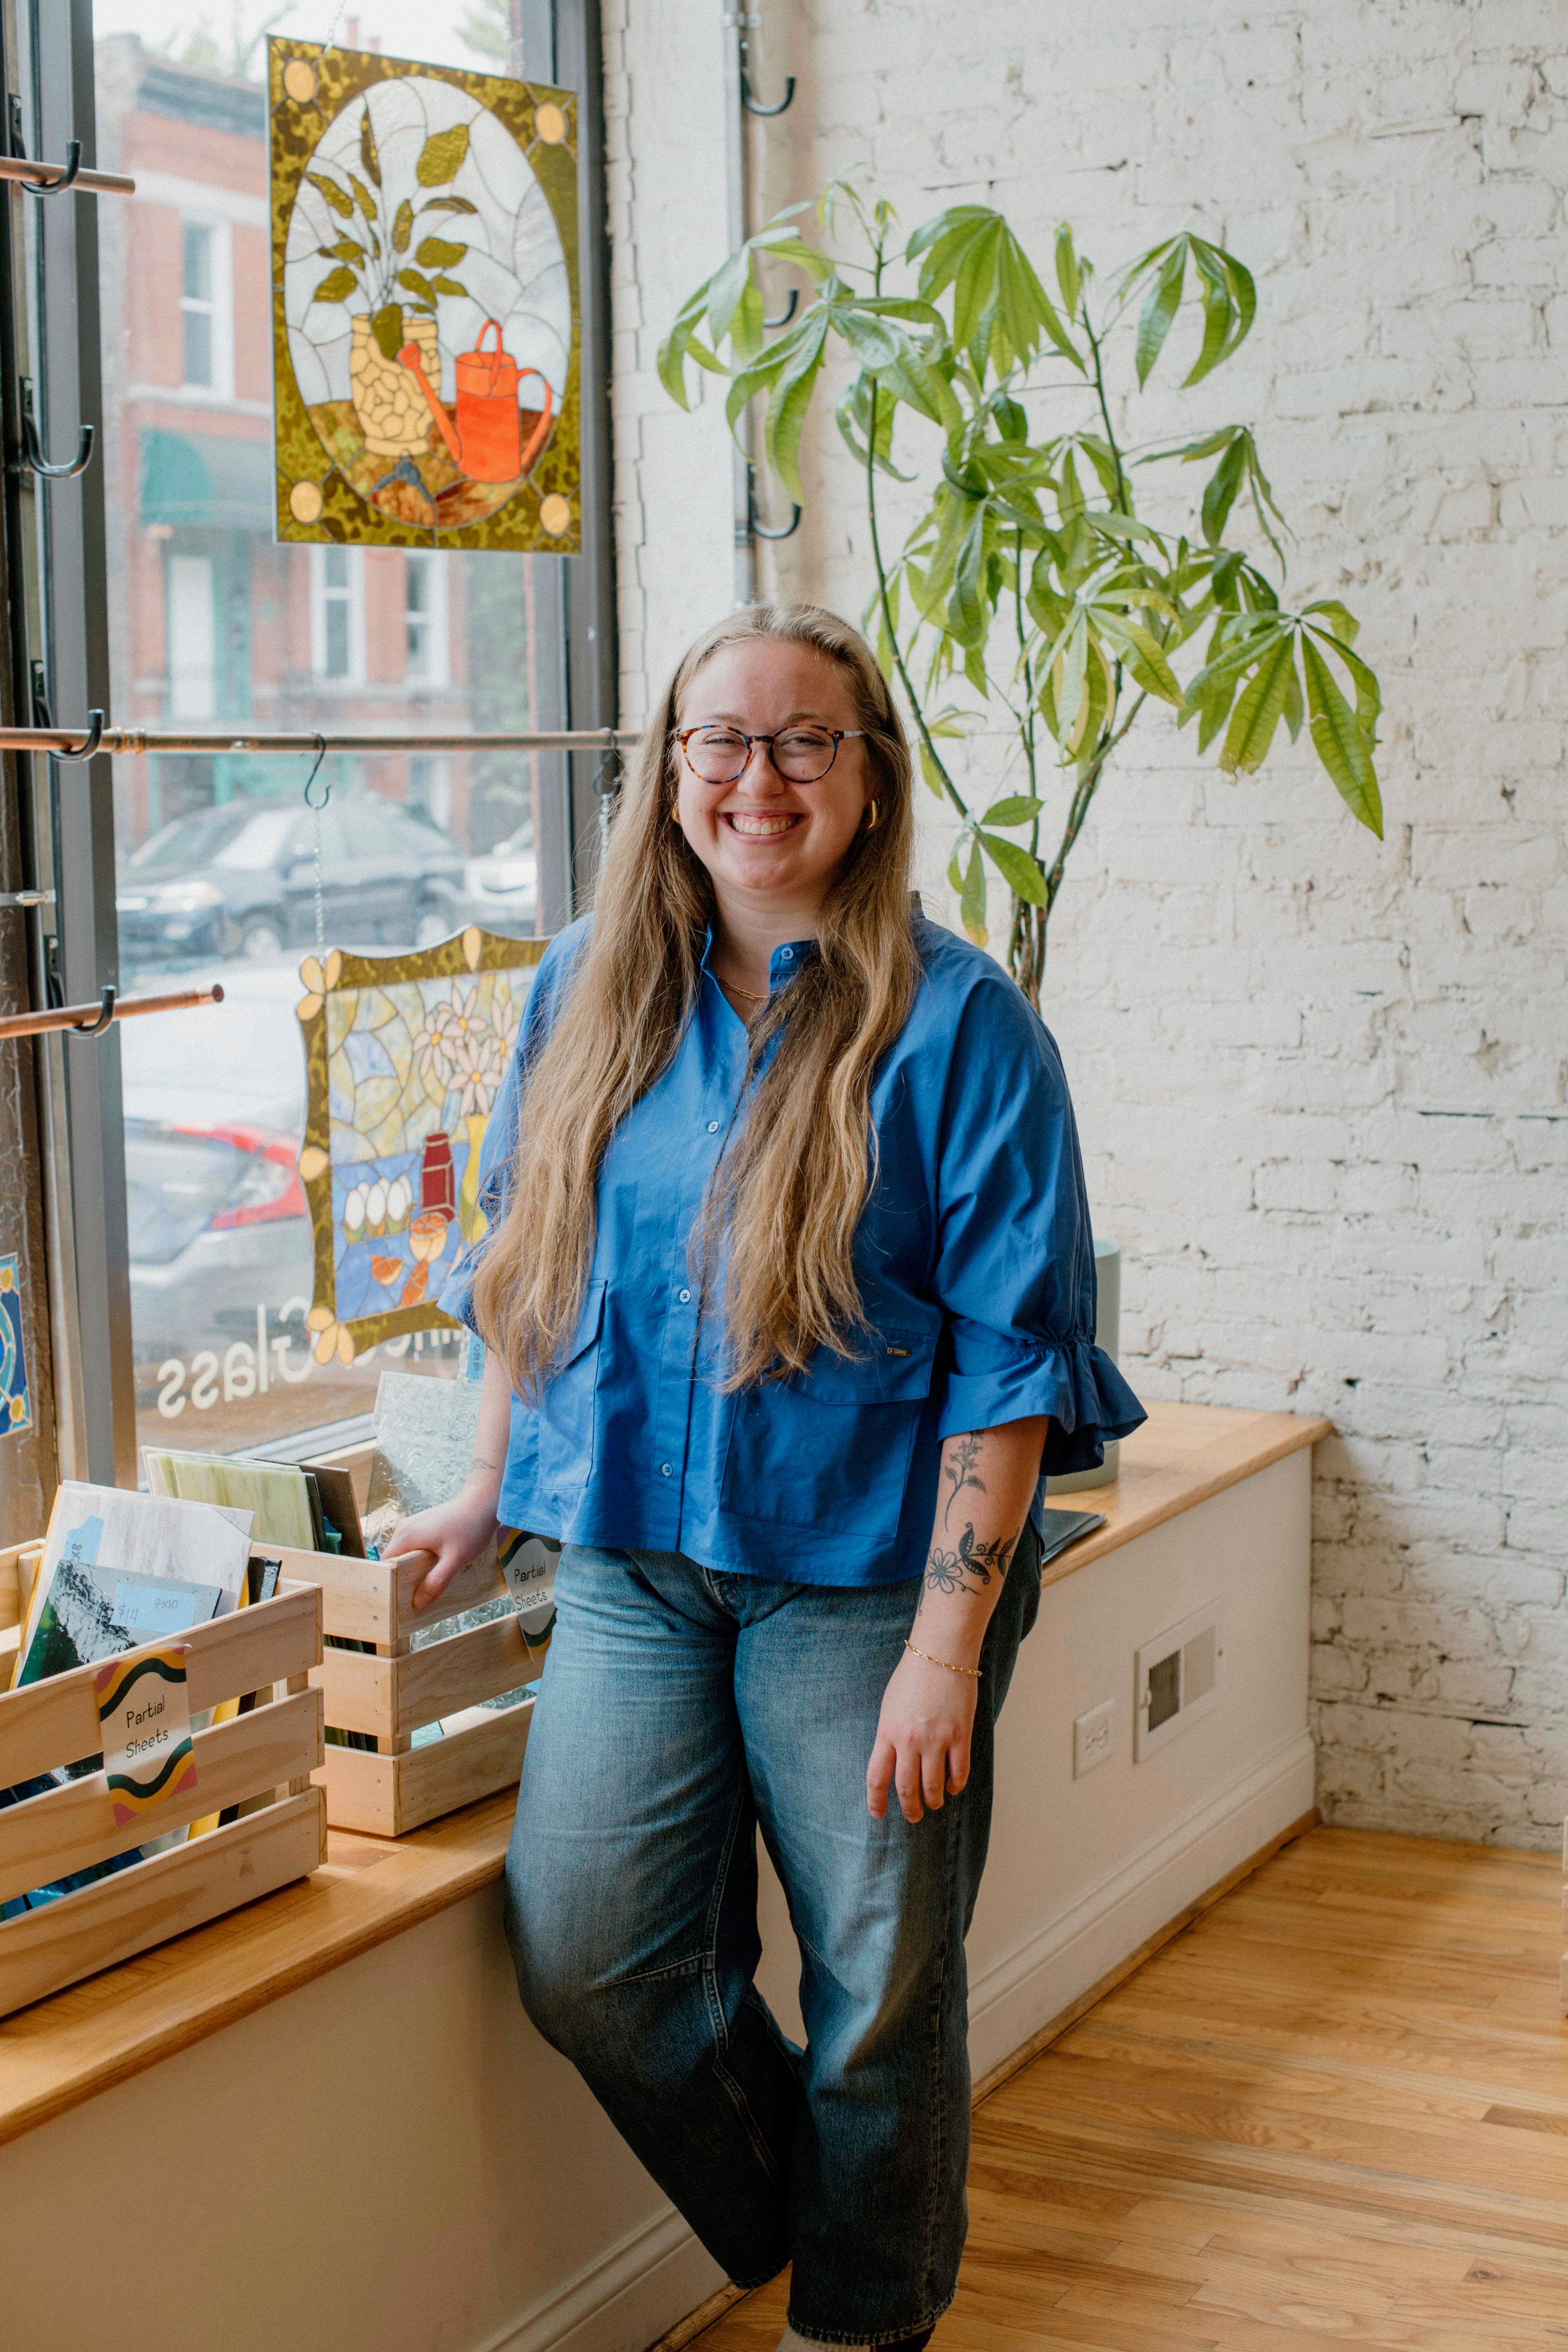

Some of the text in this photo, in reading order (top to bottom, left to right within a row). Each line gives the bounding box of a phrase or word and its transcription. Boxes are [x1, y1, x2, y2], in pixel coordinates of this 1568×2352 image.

[514, 1560, 546, 1584] Partial
[515, 1588, 547, 1610] Sheets
[118, 1603, 139, 1625] $14
[127, 1694, 165, 1728] Partial
[126, 1728, 169, 1758] Sheets
